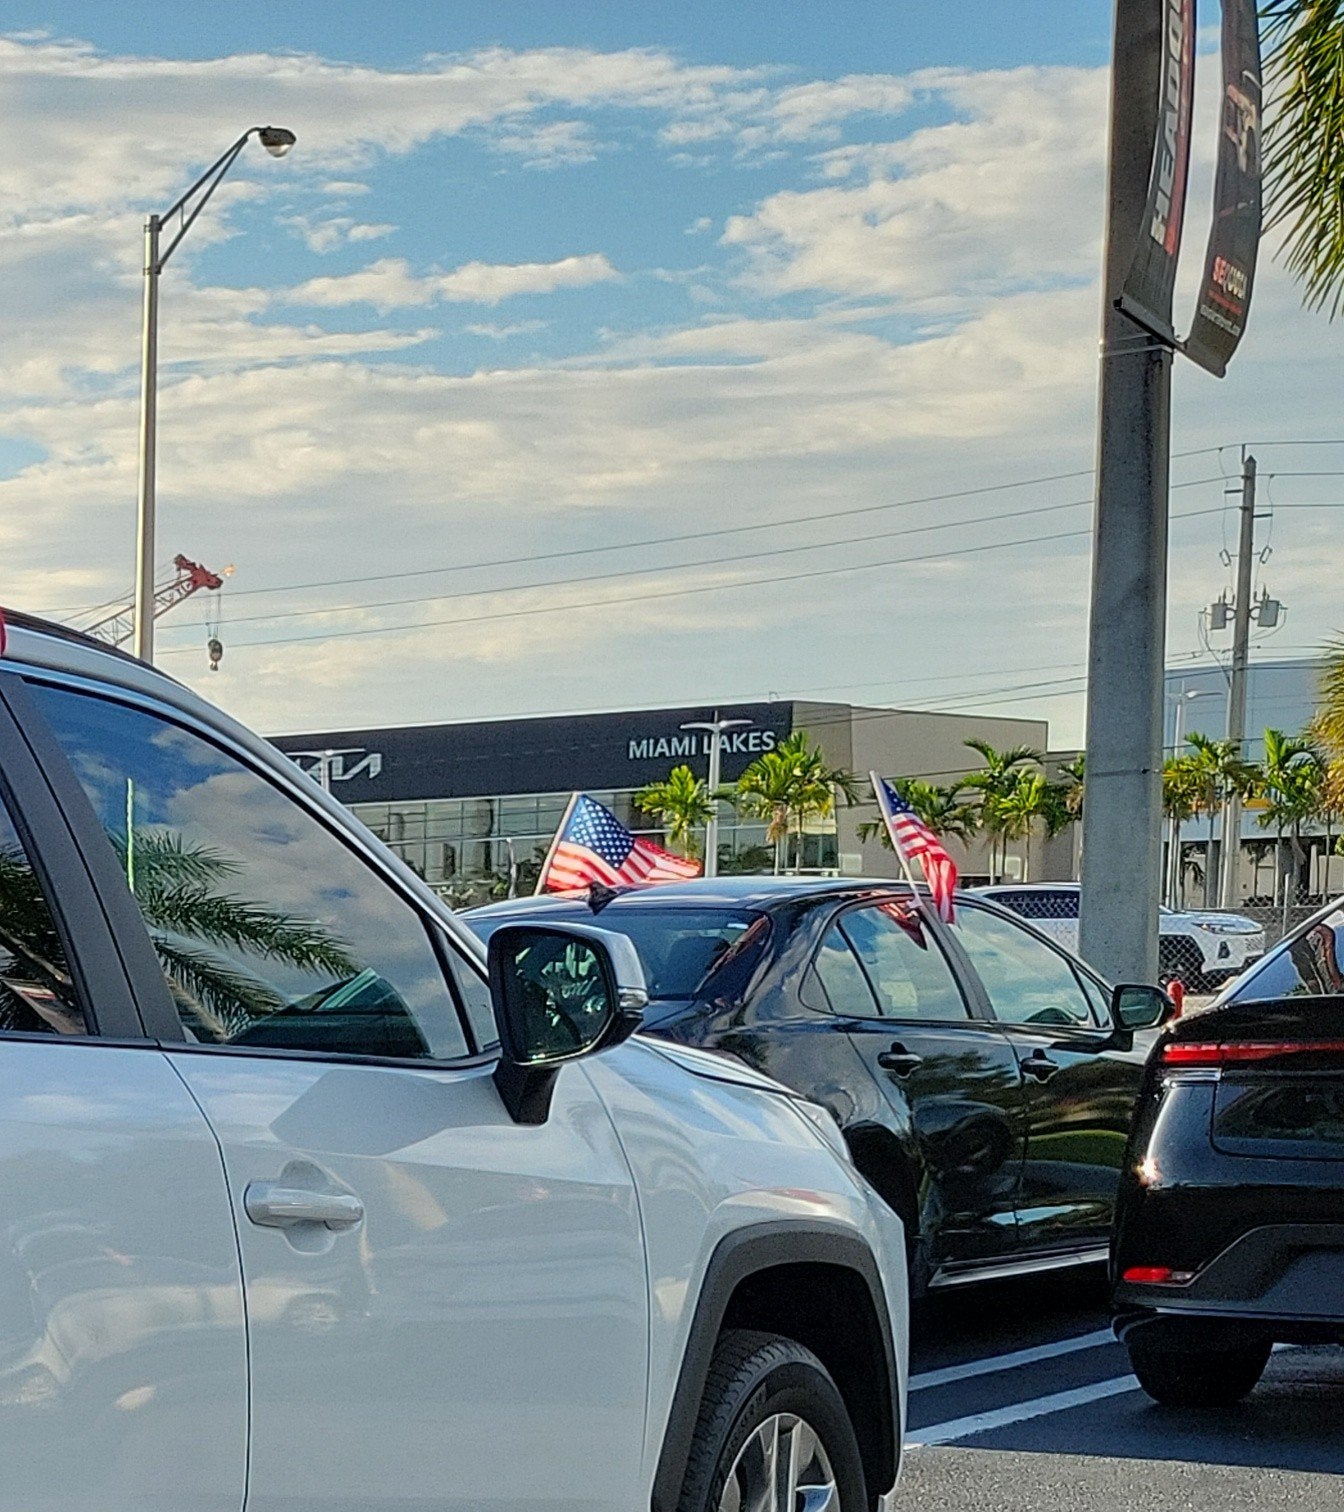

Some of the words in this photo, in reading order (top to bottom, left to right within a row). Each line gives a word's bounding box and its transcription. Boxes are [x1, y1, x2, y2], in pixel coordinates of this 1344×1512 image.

[1150, 0, 1183, 246] HEADQ
[628, 736, 697, 760] MIAMI
[702, 731, 776, 755] LAKES
